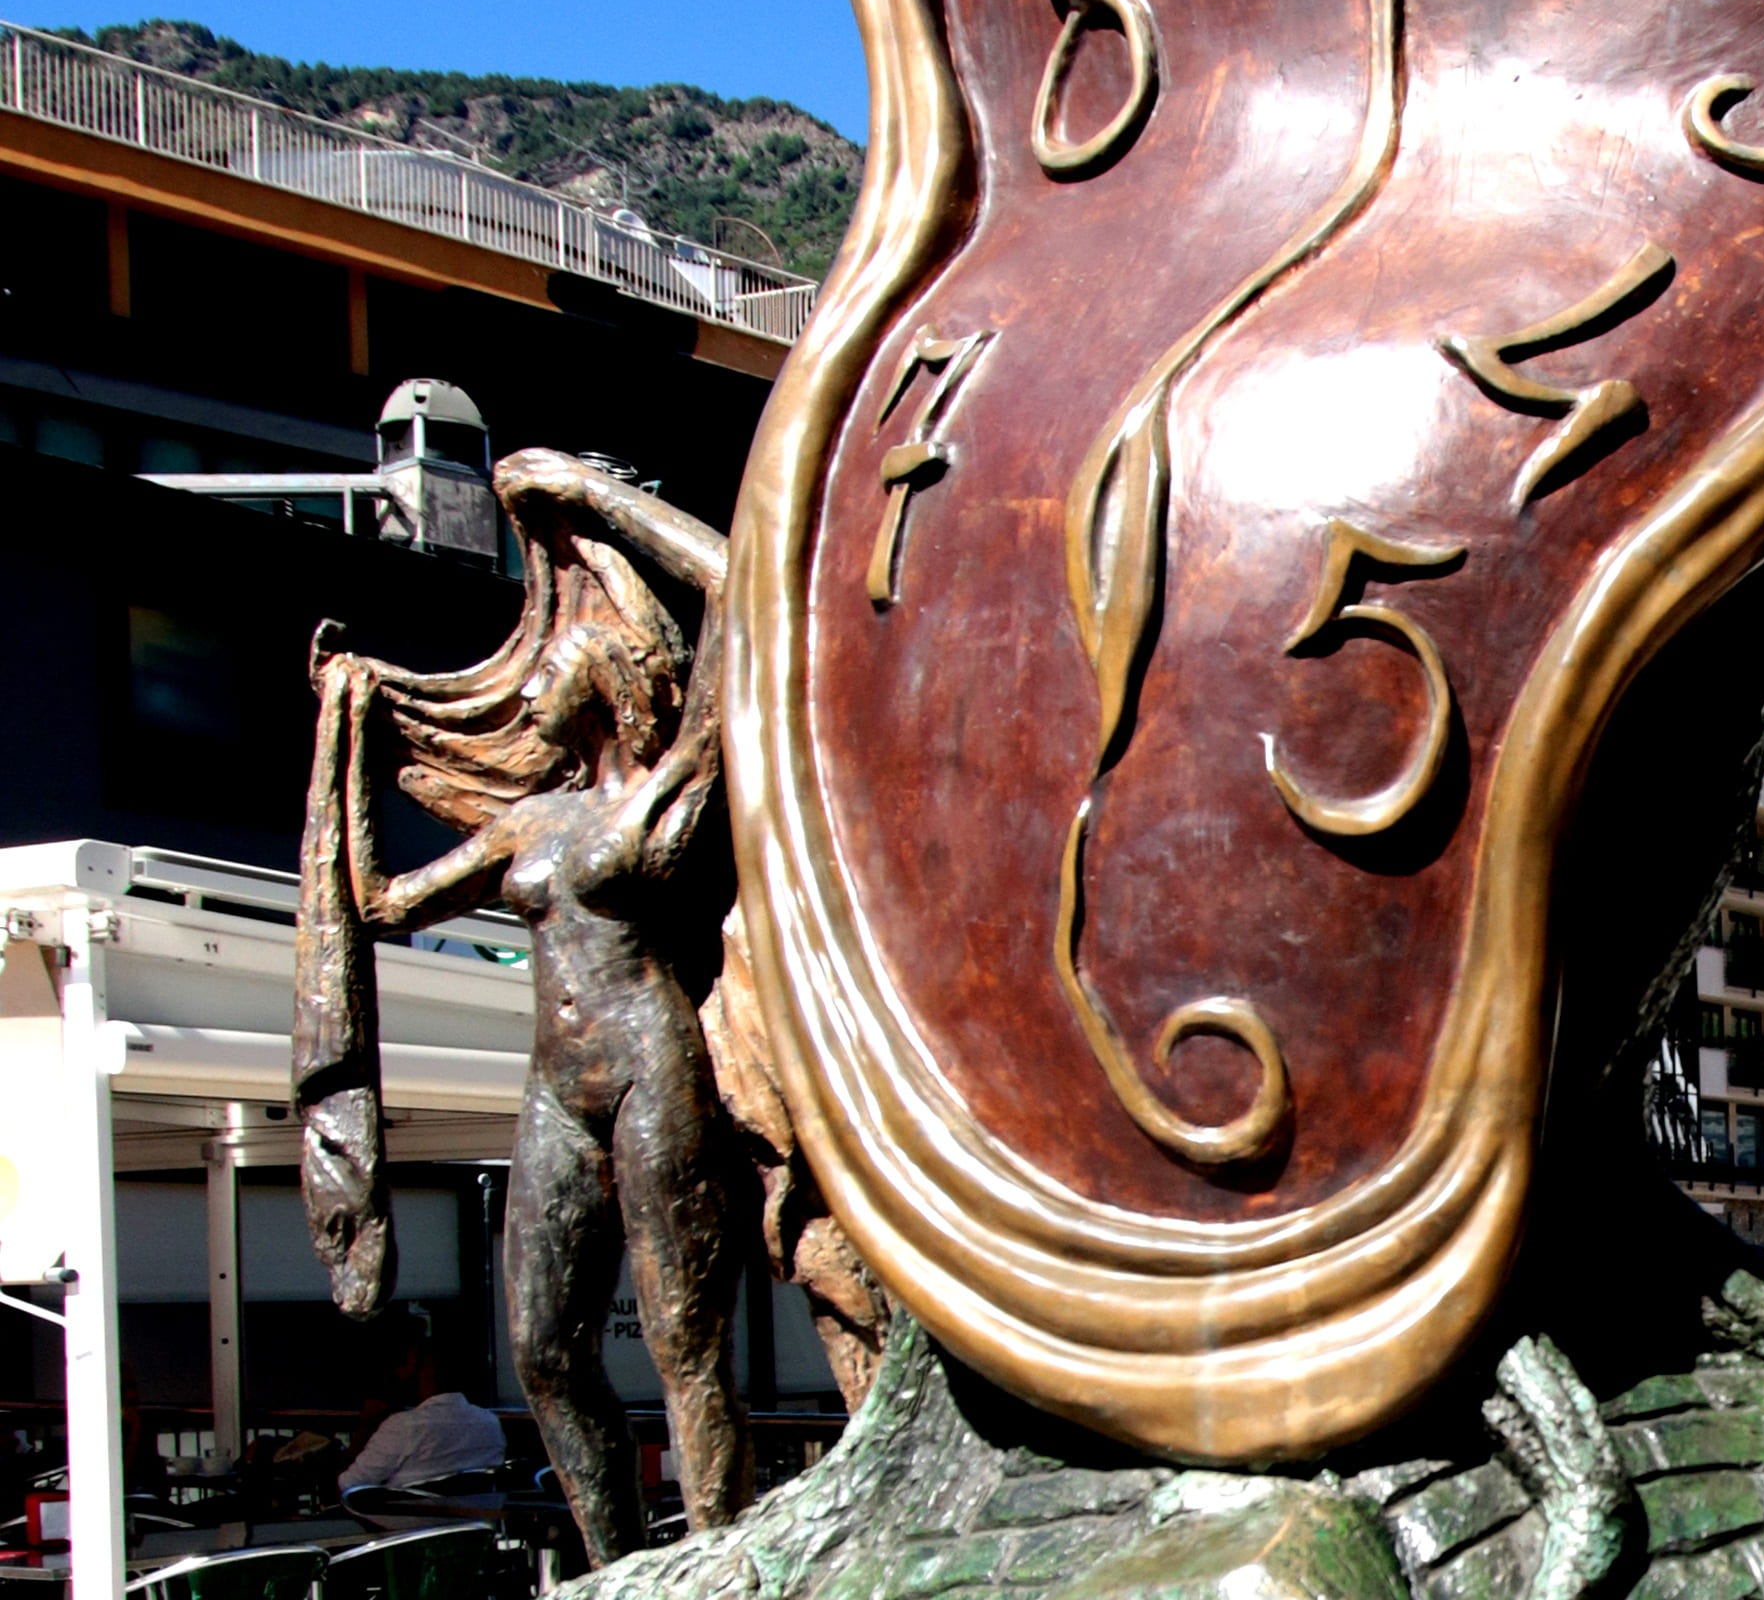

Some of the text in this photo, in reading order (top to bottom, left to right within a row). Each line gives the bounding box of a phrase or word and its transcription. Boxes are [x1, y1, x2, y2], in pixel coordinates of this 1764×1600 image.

[866, 323, 1002, 603] 7
[1260, 516, 1469, 837] 5
[1055, 797, 1287, 1163] 6
